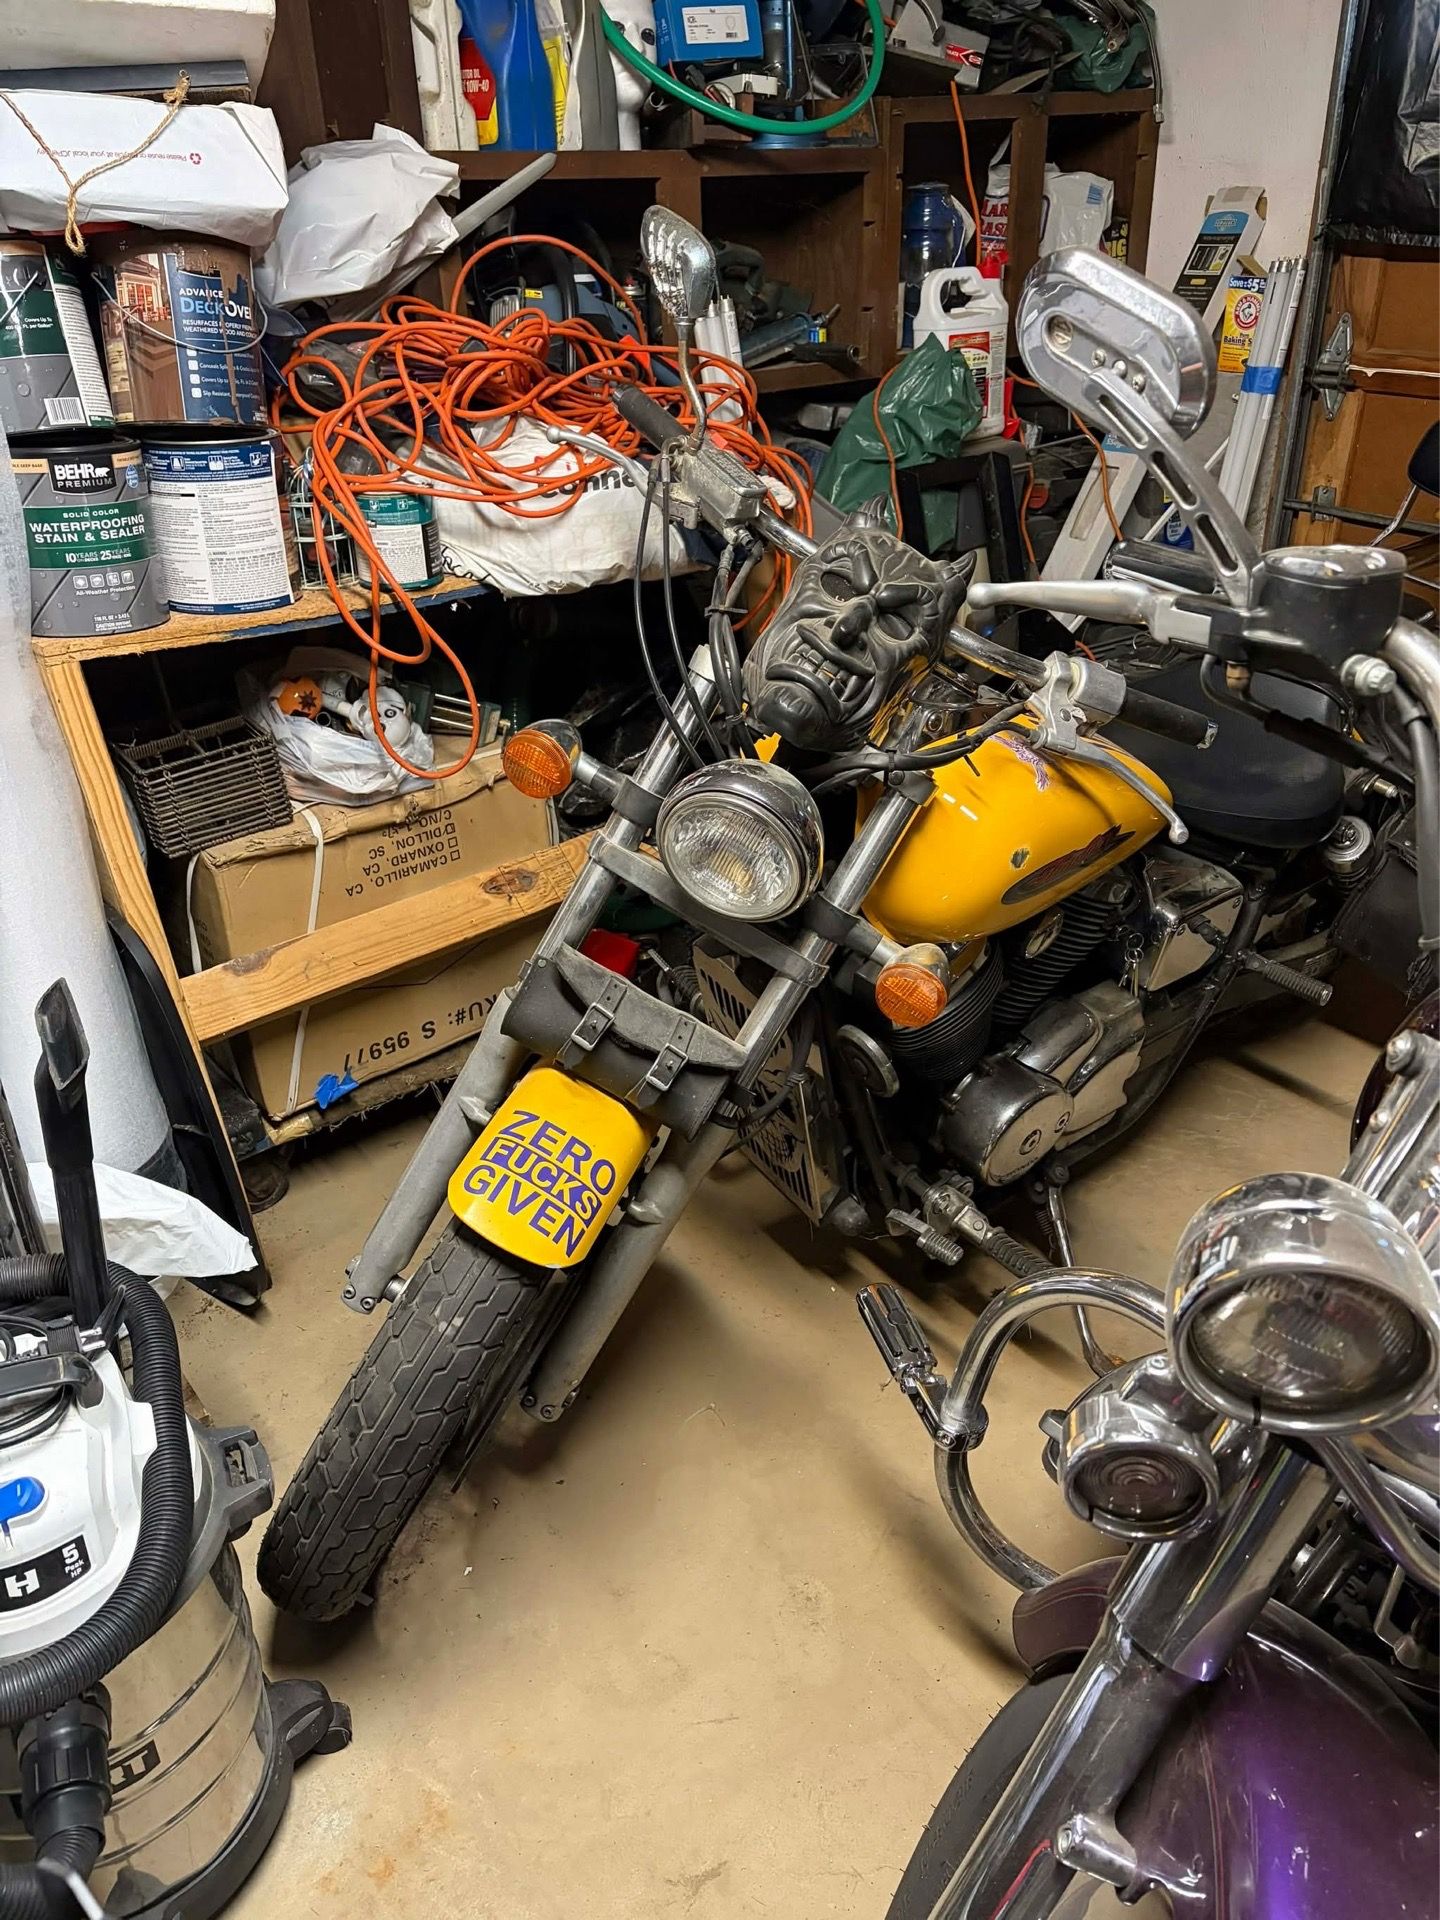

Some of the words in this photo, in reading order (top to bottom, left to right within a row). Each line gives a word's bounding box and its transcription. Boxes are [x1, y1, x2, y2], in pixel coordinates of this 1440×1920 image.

[466, 79, 489, 93] 10W-40
[1230, 278, 1243, 287] Save
[1248, 278, 1259, 292] $5
[183, 326, 218, 334] WEATHERED
[1224, 335, 1245, 346] Baking
[54, 463, 95, 480] BEHR
[57, 478, 112, 489] PREMIUM
[62, 510, 89, 518] SOLID
[92, 508, 119, 517] COLOR
[29, 514, 145, 533] WATERPROOFING
[35, 532, 78, 543] STAIN
[84, 532, 95, 541] &
[101, 525, 145, 540] SEALER
[65, 552, 76, 563] 10
[76, 551, 98, 559] YEARS
[100, 549, 112, 560] 25
[76, 588, 108, 596] All-Weather
[109, 585, 136, 593] Protection
[391, 827, 441, 850] DILLON,
[368, 846, 385, 860] SC
[386, 841, 445, 867] OXNARD,
[362, 863, 381, 876] CA
[370, 854, 448, 888] CAMARILLO,
[345, 883, 363, 897] CA
[421, 1020, 436, 1039] S
[500, 1110, 616, 1196] ZERO
[486, 1139, 598, 1220] FUCKS
[463, 1165, 586, 1258] GIVEN
[62, 1543, 79, 1565] 5
[65, 1559, 84, 1574] Peak
[71, 1567, 82, 1578] HP
